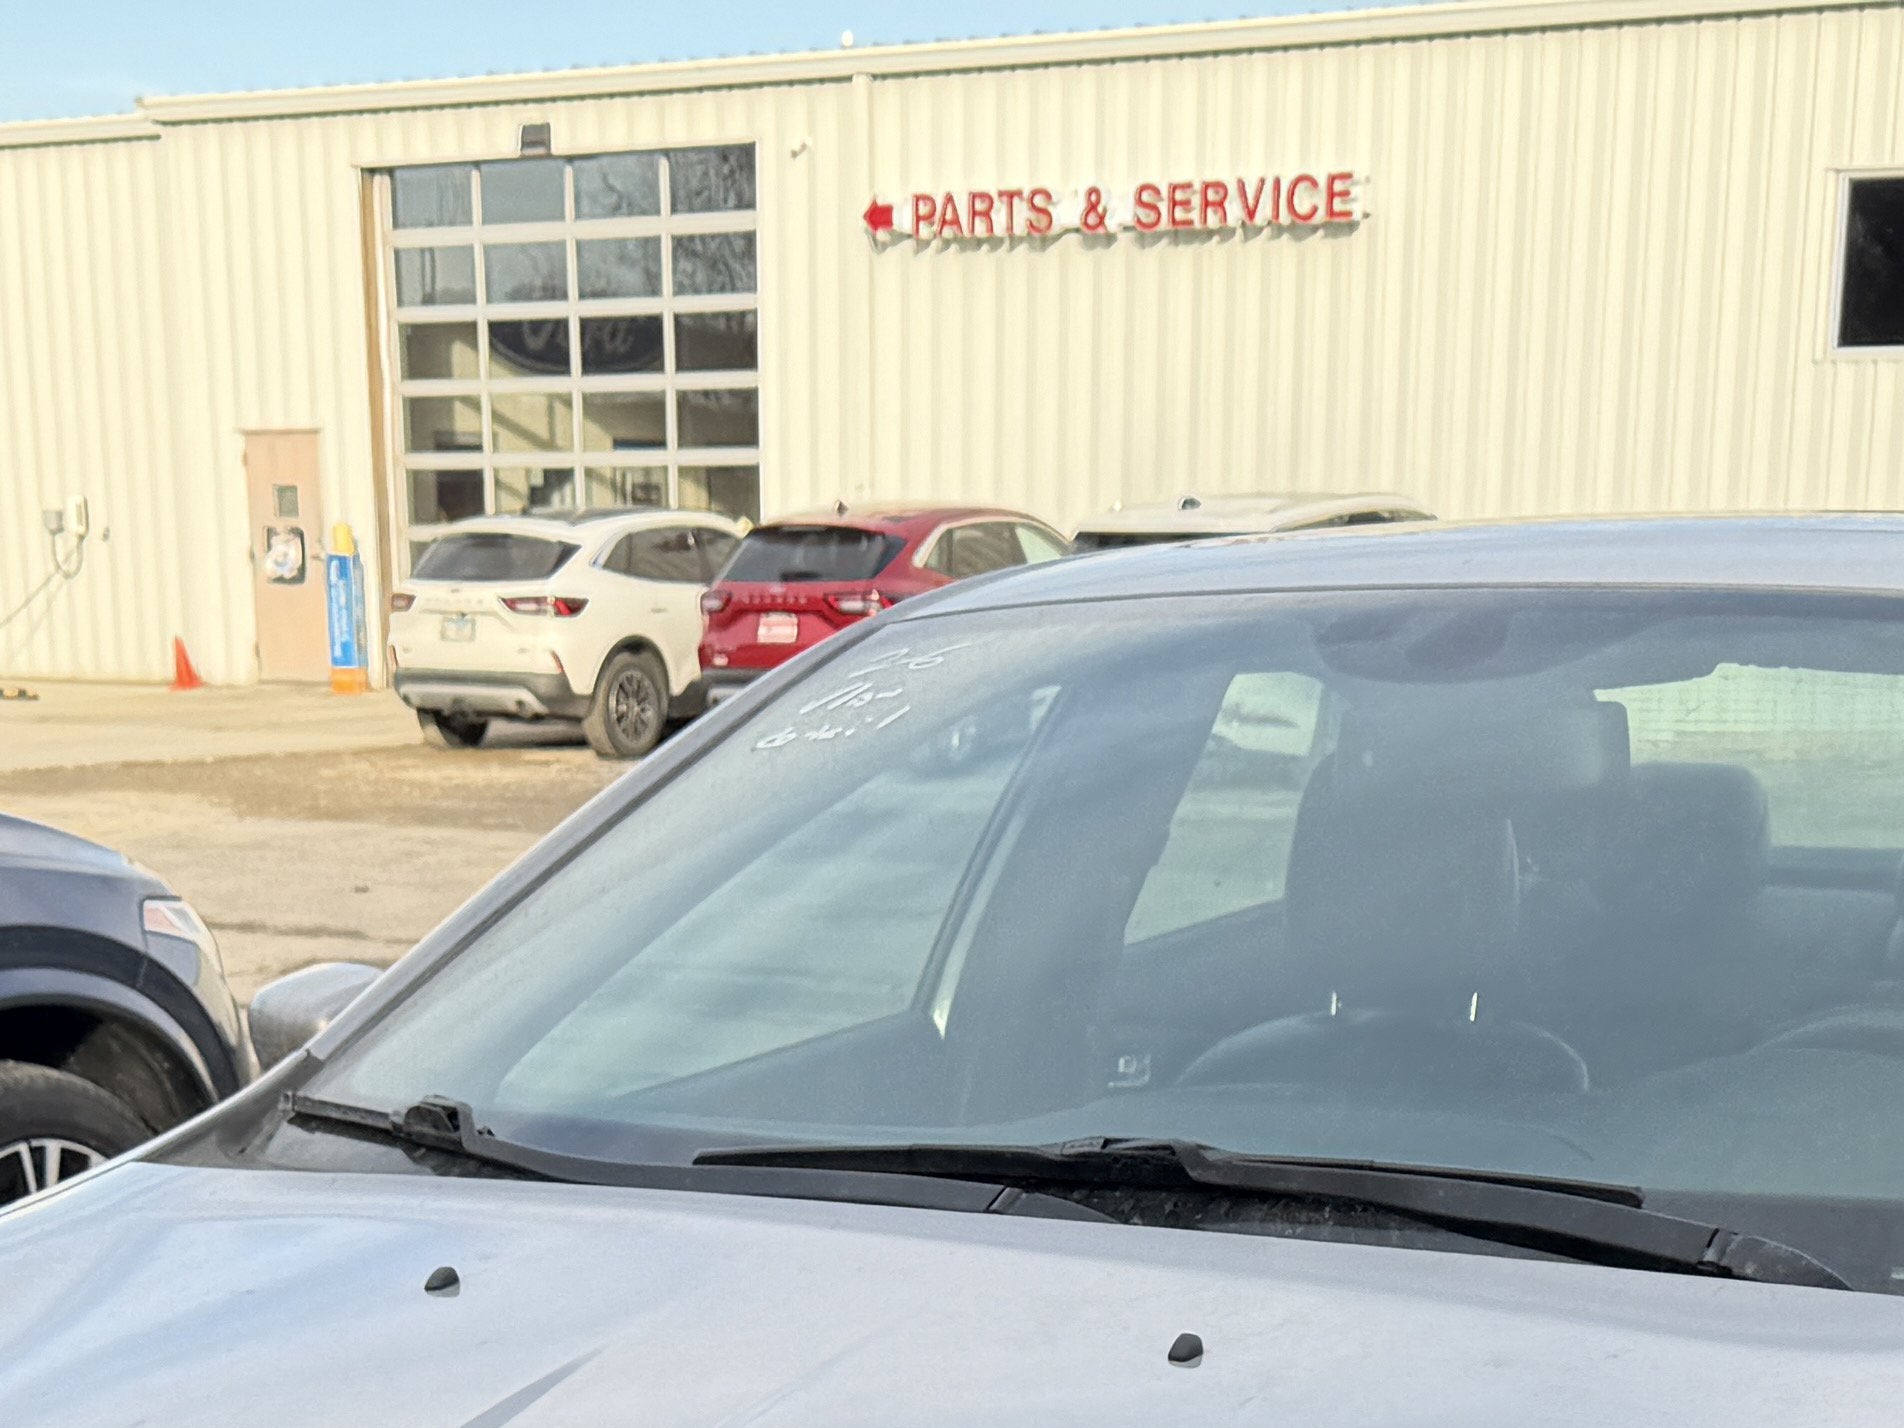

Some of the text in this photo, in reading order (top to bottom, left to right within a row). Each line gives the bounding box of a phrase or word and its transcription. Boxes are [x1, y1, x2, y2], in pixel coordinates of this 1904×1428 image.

[912, 172, 1354, 240] PARTS & SERVICE
